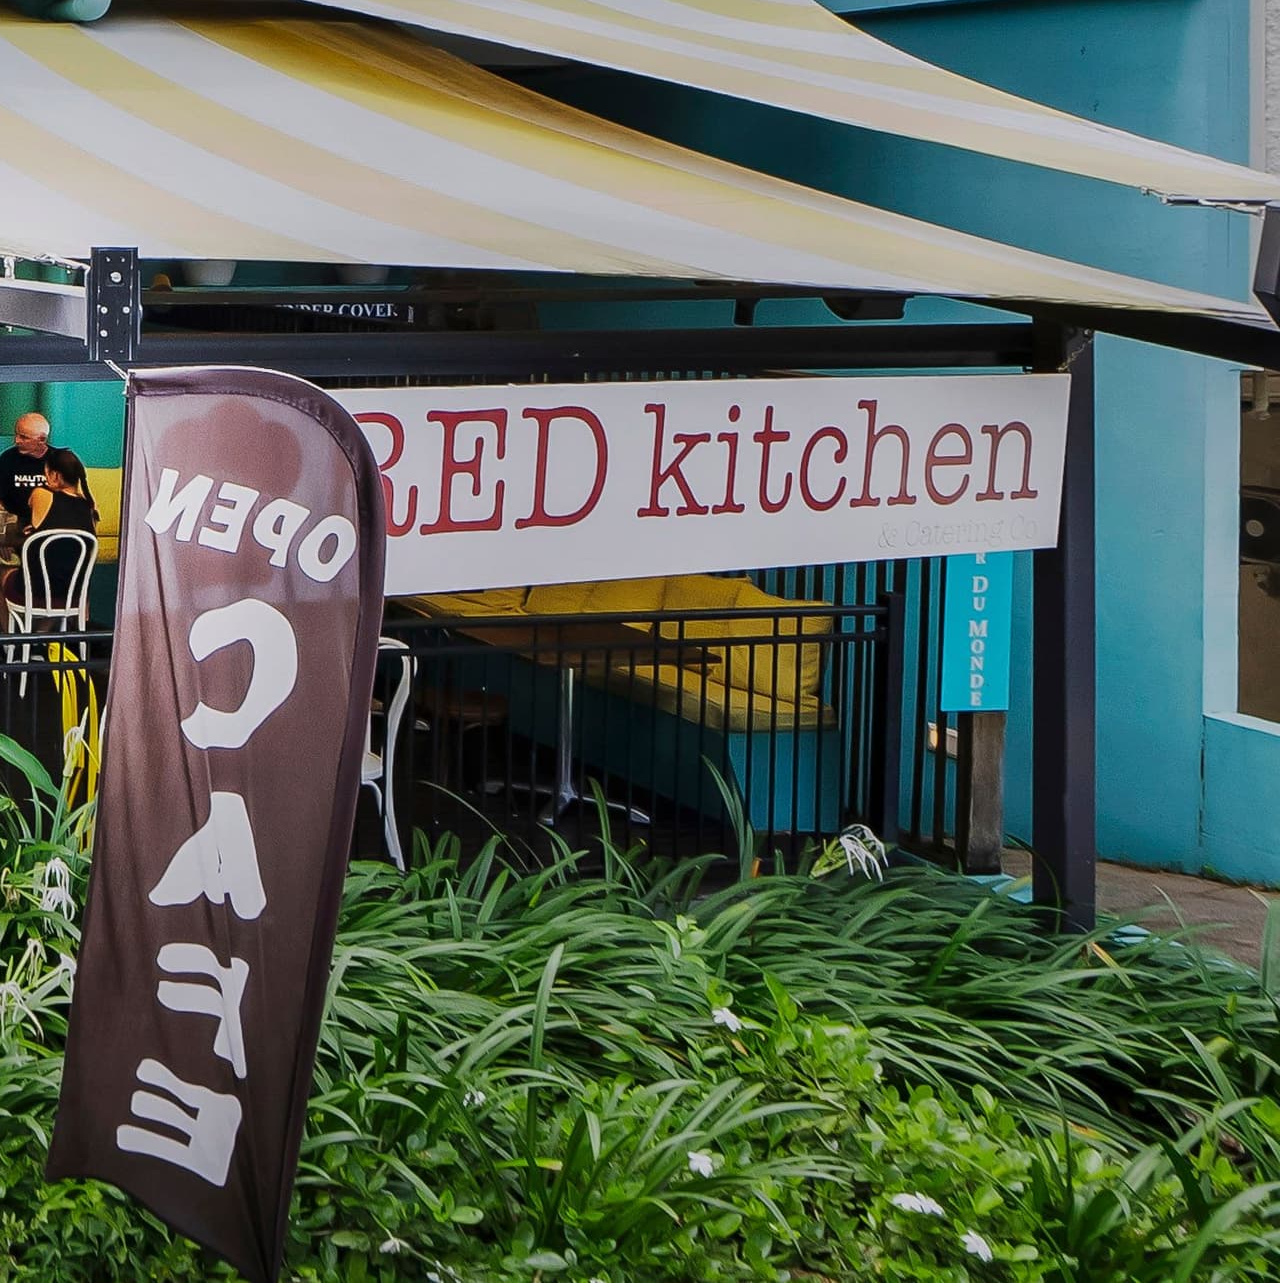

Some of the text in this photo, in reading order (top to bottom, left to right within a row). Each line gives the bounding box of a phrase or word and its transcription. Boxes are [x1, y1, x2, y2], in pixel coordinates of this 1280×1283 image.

[351, 399, 1039, 537] RED kitchen
[878, 525, 898, 549] &
[904, 519, 1005, 547] Catering
[968, 620, 989, 707] MONDE
